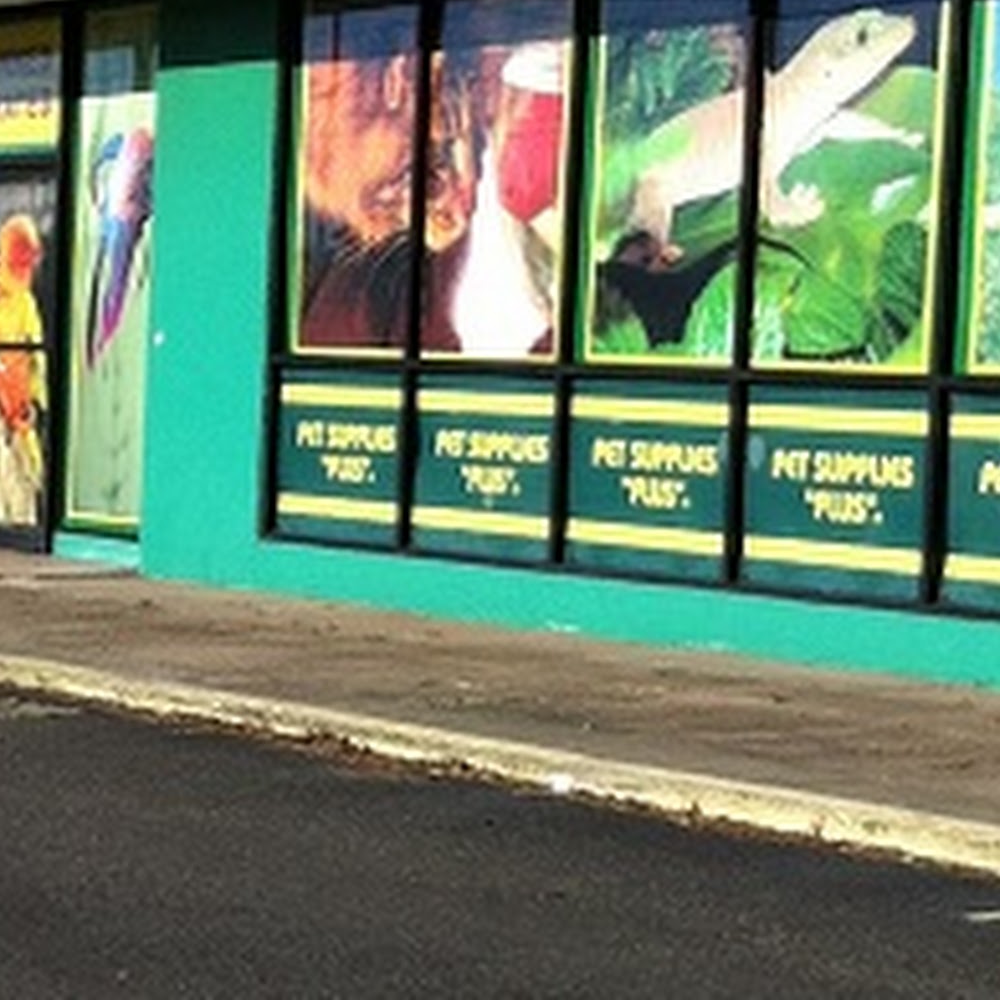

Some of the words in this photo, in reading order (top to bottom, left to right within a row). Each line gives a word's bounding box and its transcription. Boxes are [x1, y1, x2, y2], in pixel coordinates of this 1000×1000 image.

[296, 420, 324, 448] PET
[327, 423, 397, 452] SUPPLIES
[435, 429, 467, 458] PET
[468, 432, 549, 464] SUPPLIES
[592, 438, 627, 468] PET
[629, 439, 719, 475] SUPPLIES
[771, 449, 811, 480] PET
[813, 451, 914, 489] SUPPLIES
